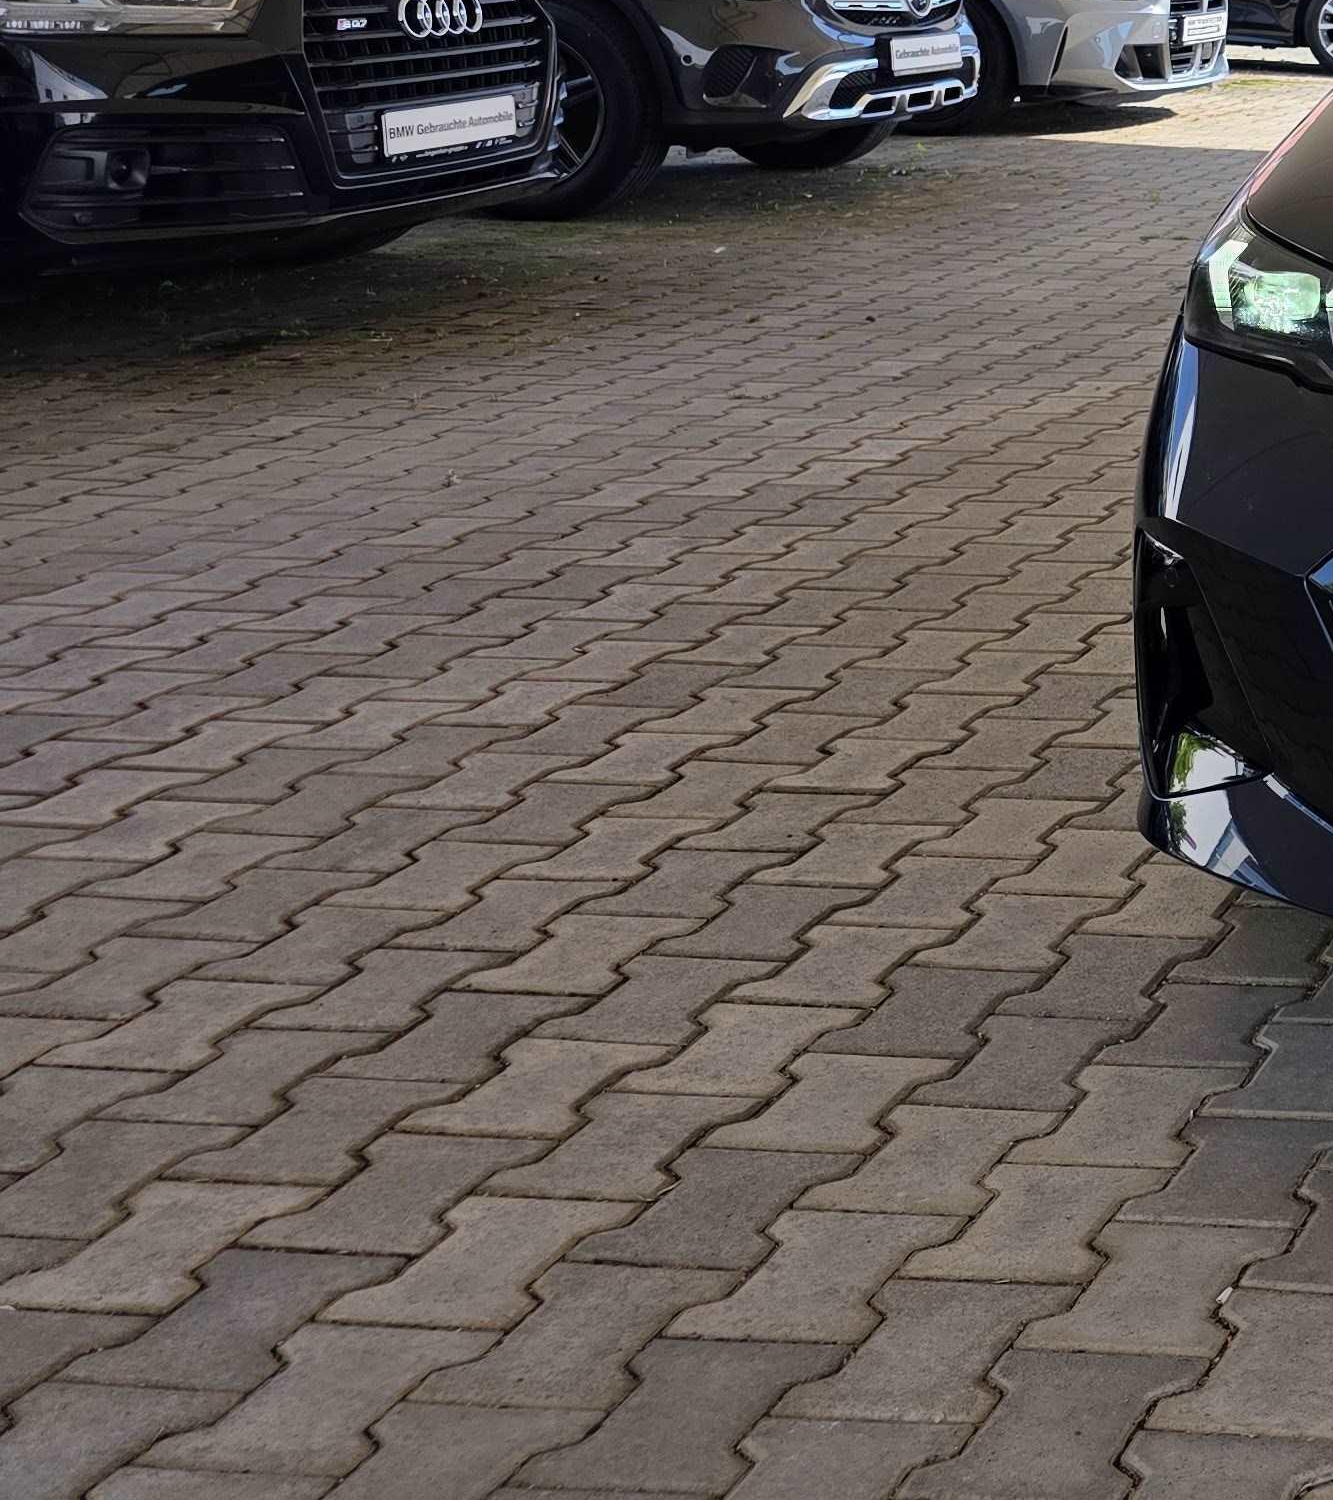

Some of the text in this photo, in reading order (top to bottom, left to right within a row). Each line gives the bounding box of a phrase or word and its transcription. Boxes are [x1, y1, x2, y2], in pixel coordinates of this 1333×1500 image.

[389, 111, 514, 140] BMW Gebrauchte Automobile
